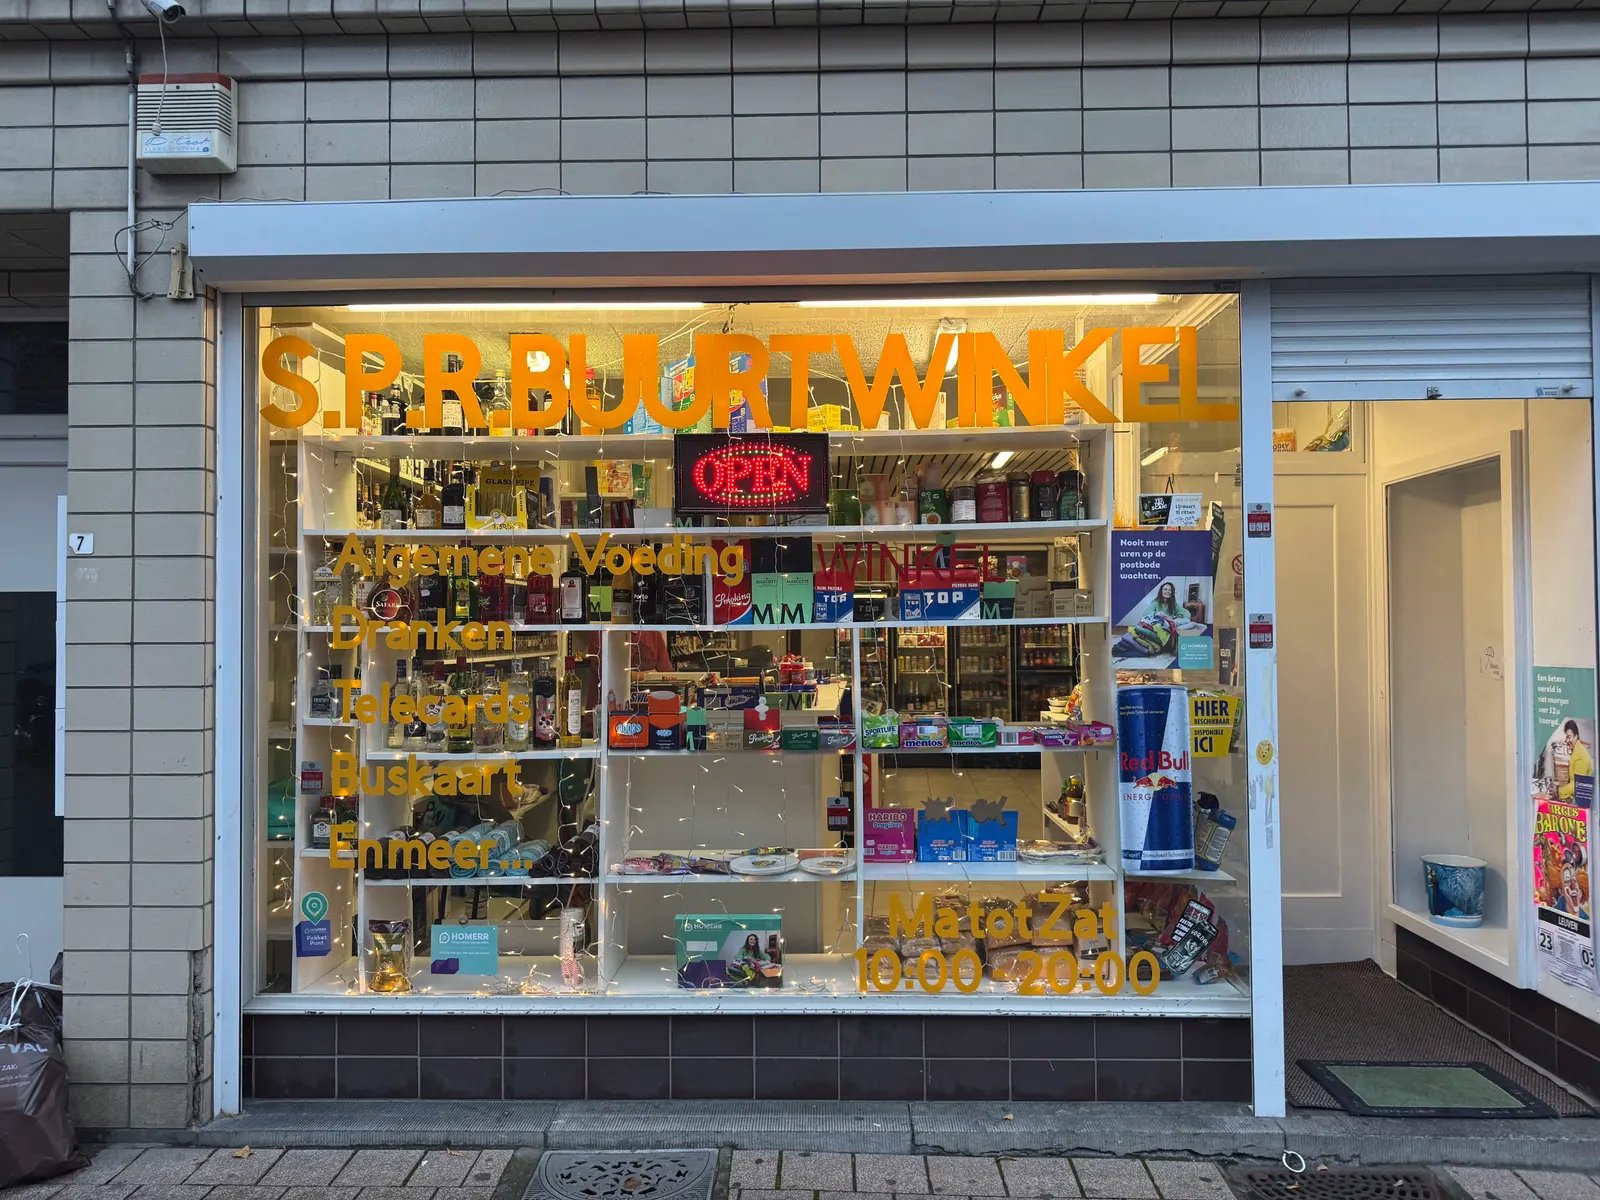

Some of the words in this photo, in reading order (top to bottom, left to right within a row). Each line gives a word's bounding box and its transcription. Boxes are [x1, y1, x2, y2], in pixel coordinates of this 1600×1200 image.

[692, 454, 812, 493] OPEN
[77, 535, 85, 551] 7
[1120, 539, 1145, 547] Nooit
[333, 532, 556, 587] Algemene
[569, 531, 744, 586] Voeding
[1155, 550, 1166, 558] de
[816, 544, 1006, 583] WINKEL
[1120, 561, 1161, 570] postbode
[1120, 572, 1162, 580] wachten.
[714, 592, 751, 609] Smoking
[332, 605, 513, 650] Dranken
[1537, 685, 1556, 693] wereld
[332, 679, 532, 724] Telecards
[1194, 700, 1230, 717] HIER
[864, 725, 897, 737] SPORTLIFE
[1194, 736, 1214, 753] ICI
[1120, 750, 1155, 771] Red
[1158, 750, 1190, 771] Bull
[331, 752, 522, 797] Buskaart
[868, 813, 908, 821] HARIBO
[877, 843, 899, 851] HARIBO
[693, 922, 723, 930] HOMERR
[1557, 915, 1579, 932] LEUVEN
[451, 932, 490, 940] HOMERR
[1540, 932, 1553, 951] 23
[854, 948, 983, 994] 10:00
[1018, 950, 1161, 996] 20:00
